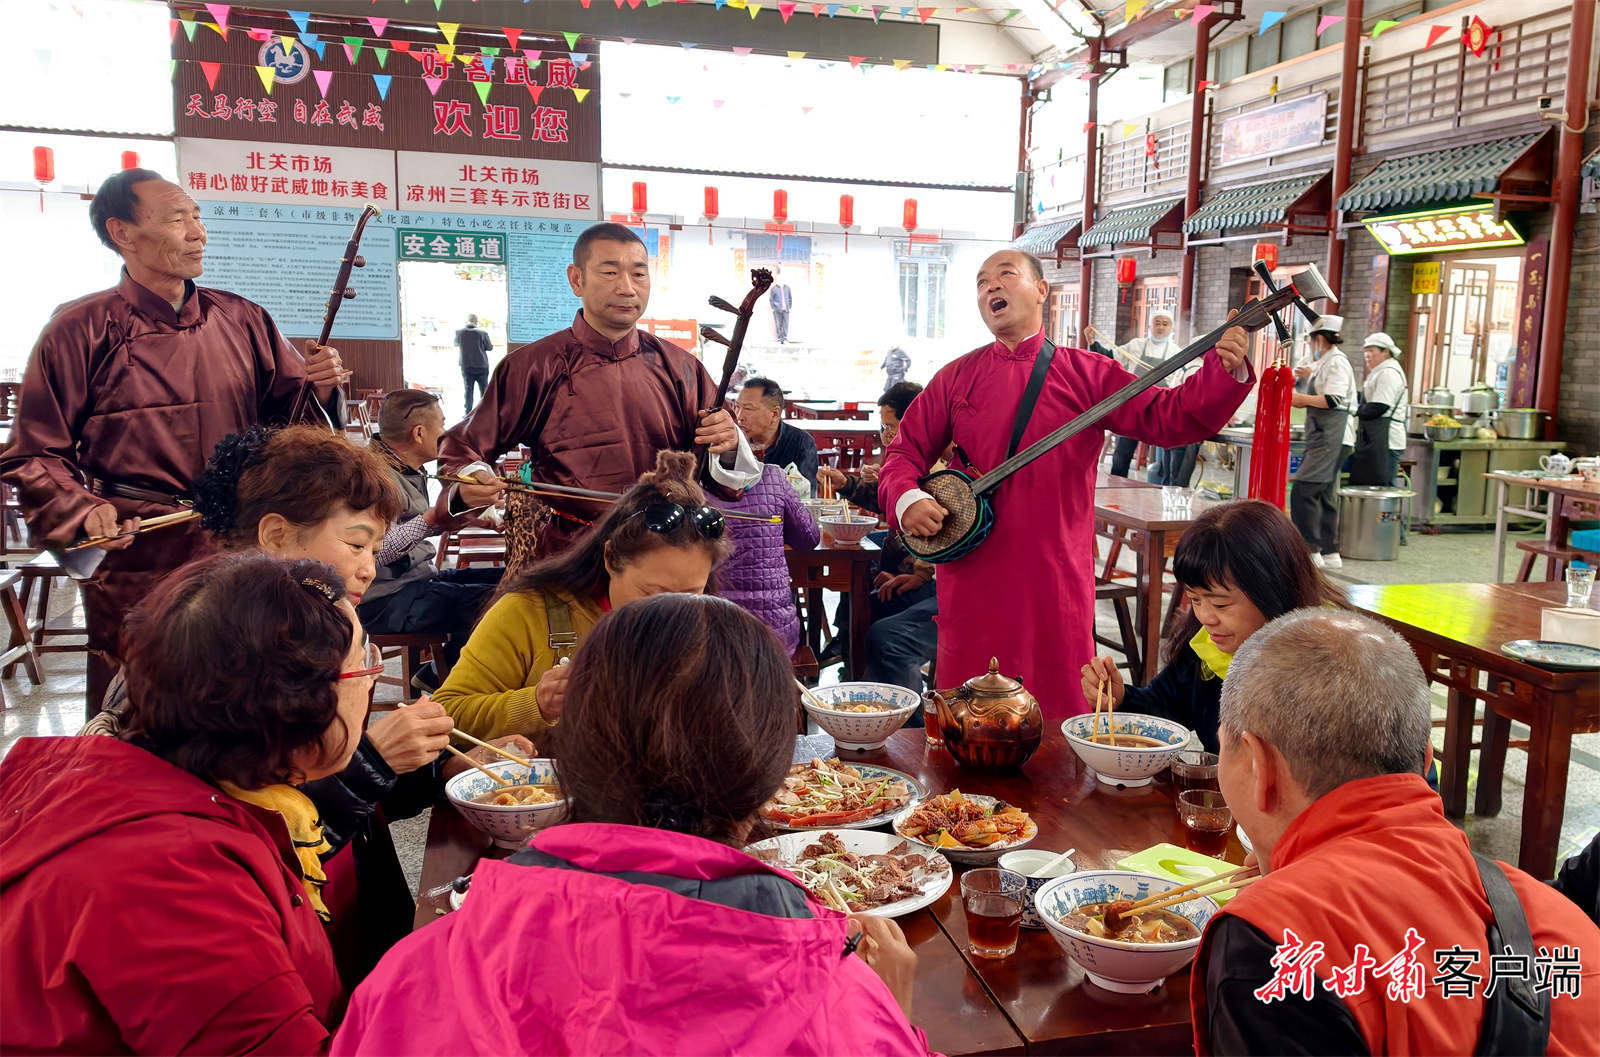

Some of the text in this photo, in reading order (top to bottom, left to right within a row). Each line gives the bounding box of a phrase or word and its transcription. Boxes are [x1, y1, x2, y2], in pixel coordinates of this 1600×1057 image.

[421, 48, 578, 89] 好客武威
[185, 93, 384, 132] 天马行空 自在武威
[433, 99, 569, 143] 欢迎您
[246, 151, 332, 175] 北关市场
[458, 164, 540, 187] 北关市场
[188, 171, 389, 201] 精心做好武威地标美食
[406, 184, 592, 211] 凉州三套车示范街区
[403, 233, 501, 259] 安全通道
